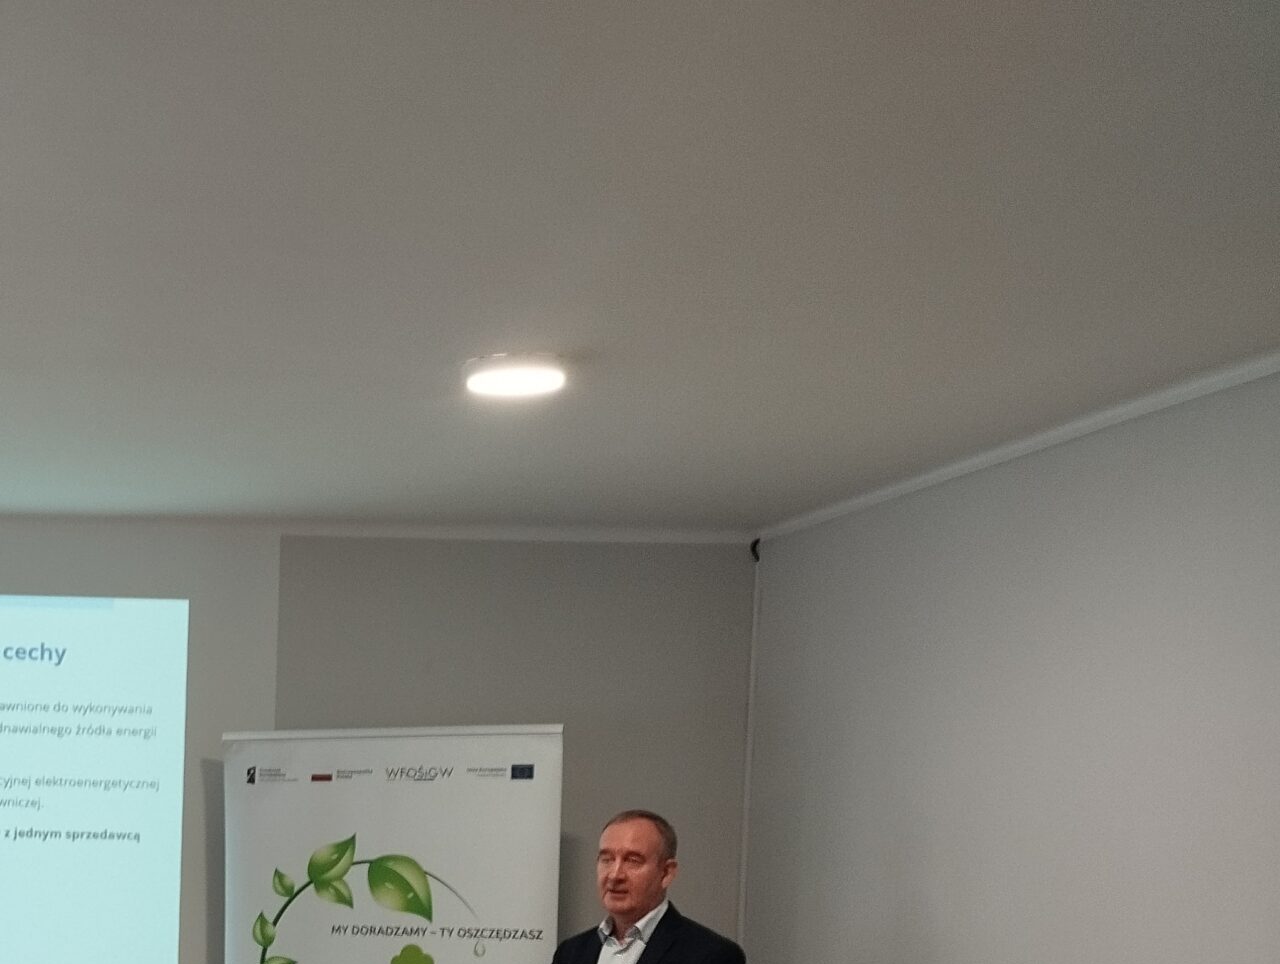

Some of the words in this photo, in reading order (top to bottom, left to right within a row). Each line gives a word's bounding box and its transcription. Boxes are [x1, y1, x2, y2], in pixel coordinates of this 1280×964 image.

[2, 641, 67, 667] cechy
[52, 700, 69, 714] do
[71, 701, 153, 718] wykonywania
[74, 722, 113, 737] źródła
[114, 726, 157, 740] energii
[33, 775, 160, 792] elektroenergetycznej
[3, 827, 11, 838] z
[11, 825, 62, 842] jednym
[63, 828, 141, 843] sprzedawcą
[330, 924, 349, 936] MY
[352, 924, 427, 938] DORADZAMY
[440, 927, 453, 939] TY
[457, 927, 544, 942] OSZCZĘDZASZ
